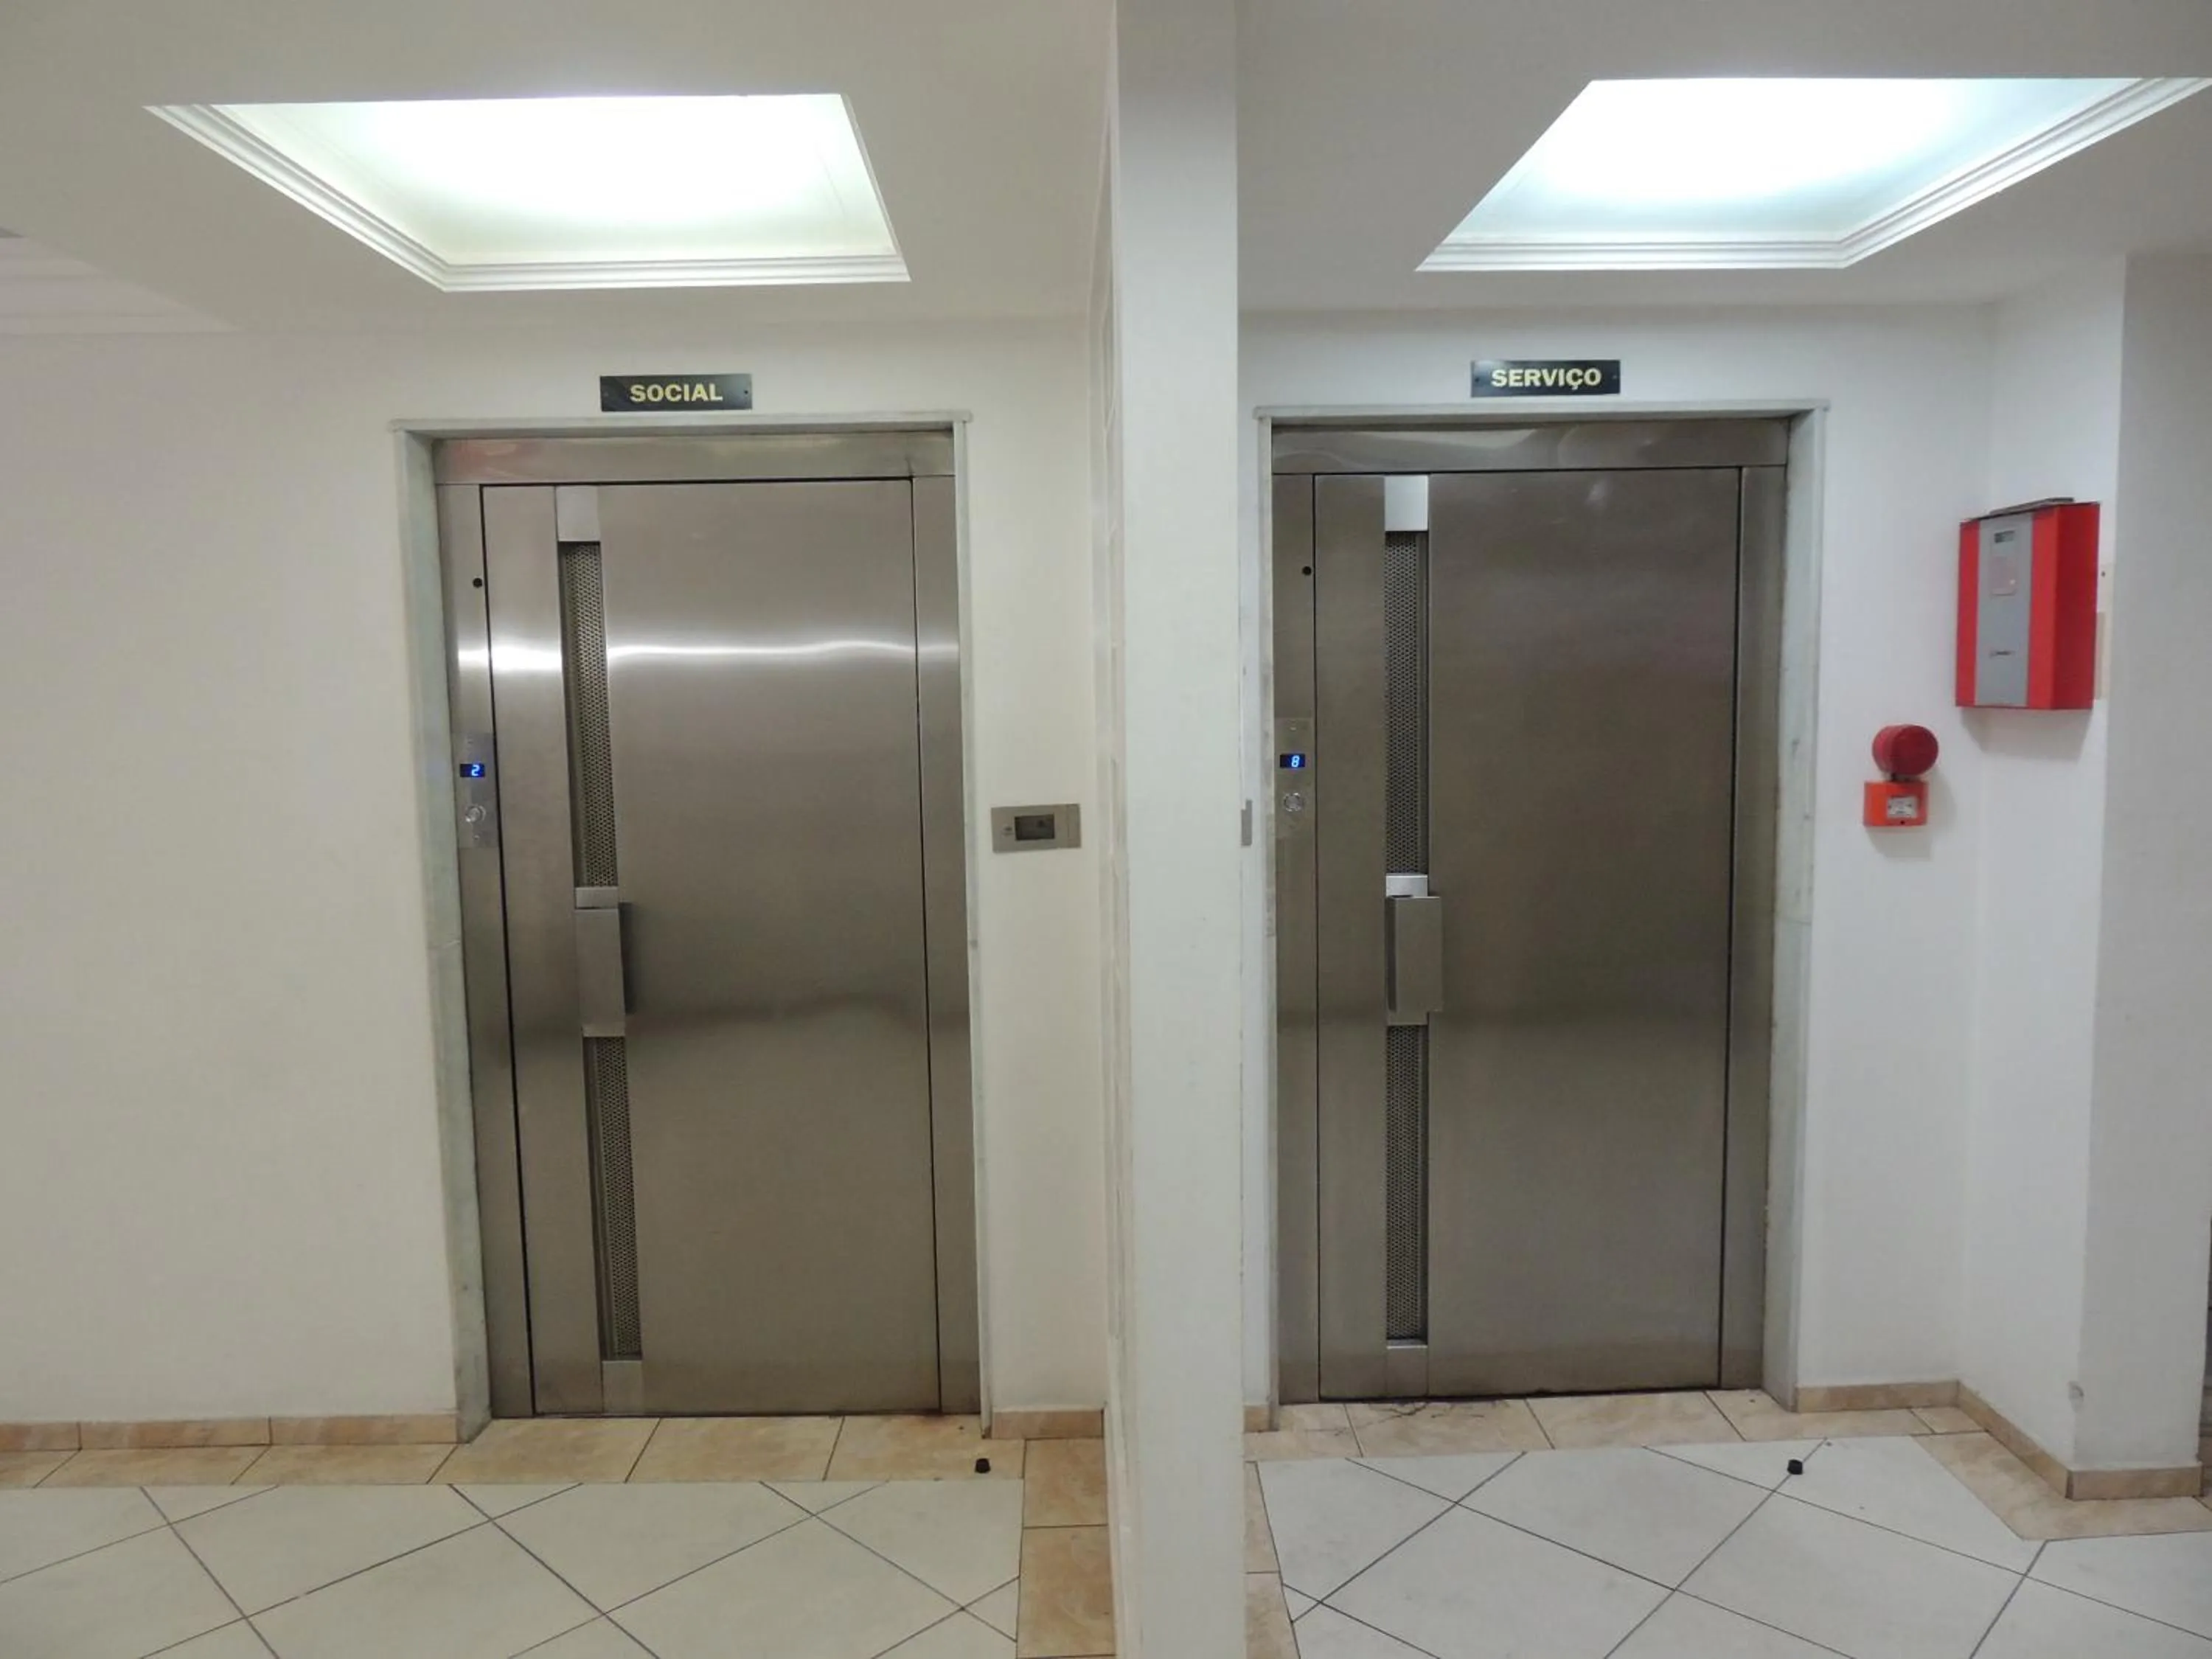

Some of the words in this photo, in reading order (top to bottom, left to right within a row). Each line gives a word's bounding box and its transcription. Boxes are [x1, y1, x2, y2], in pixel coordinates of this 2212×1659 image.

[1490, 367, 1602, 390] SERVIÇO
[630, 383, 723, 402] SOCIAL
[1291, 755, 1300, 768] 8
[471, 764, 480, 776] 2
